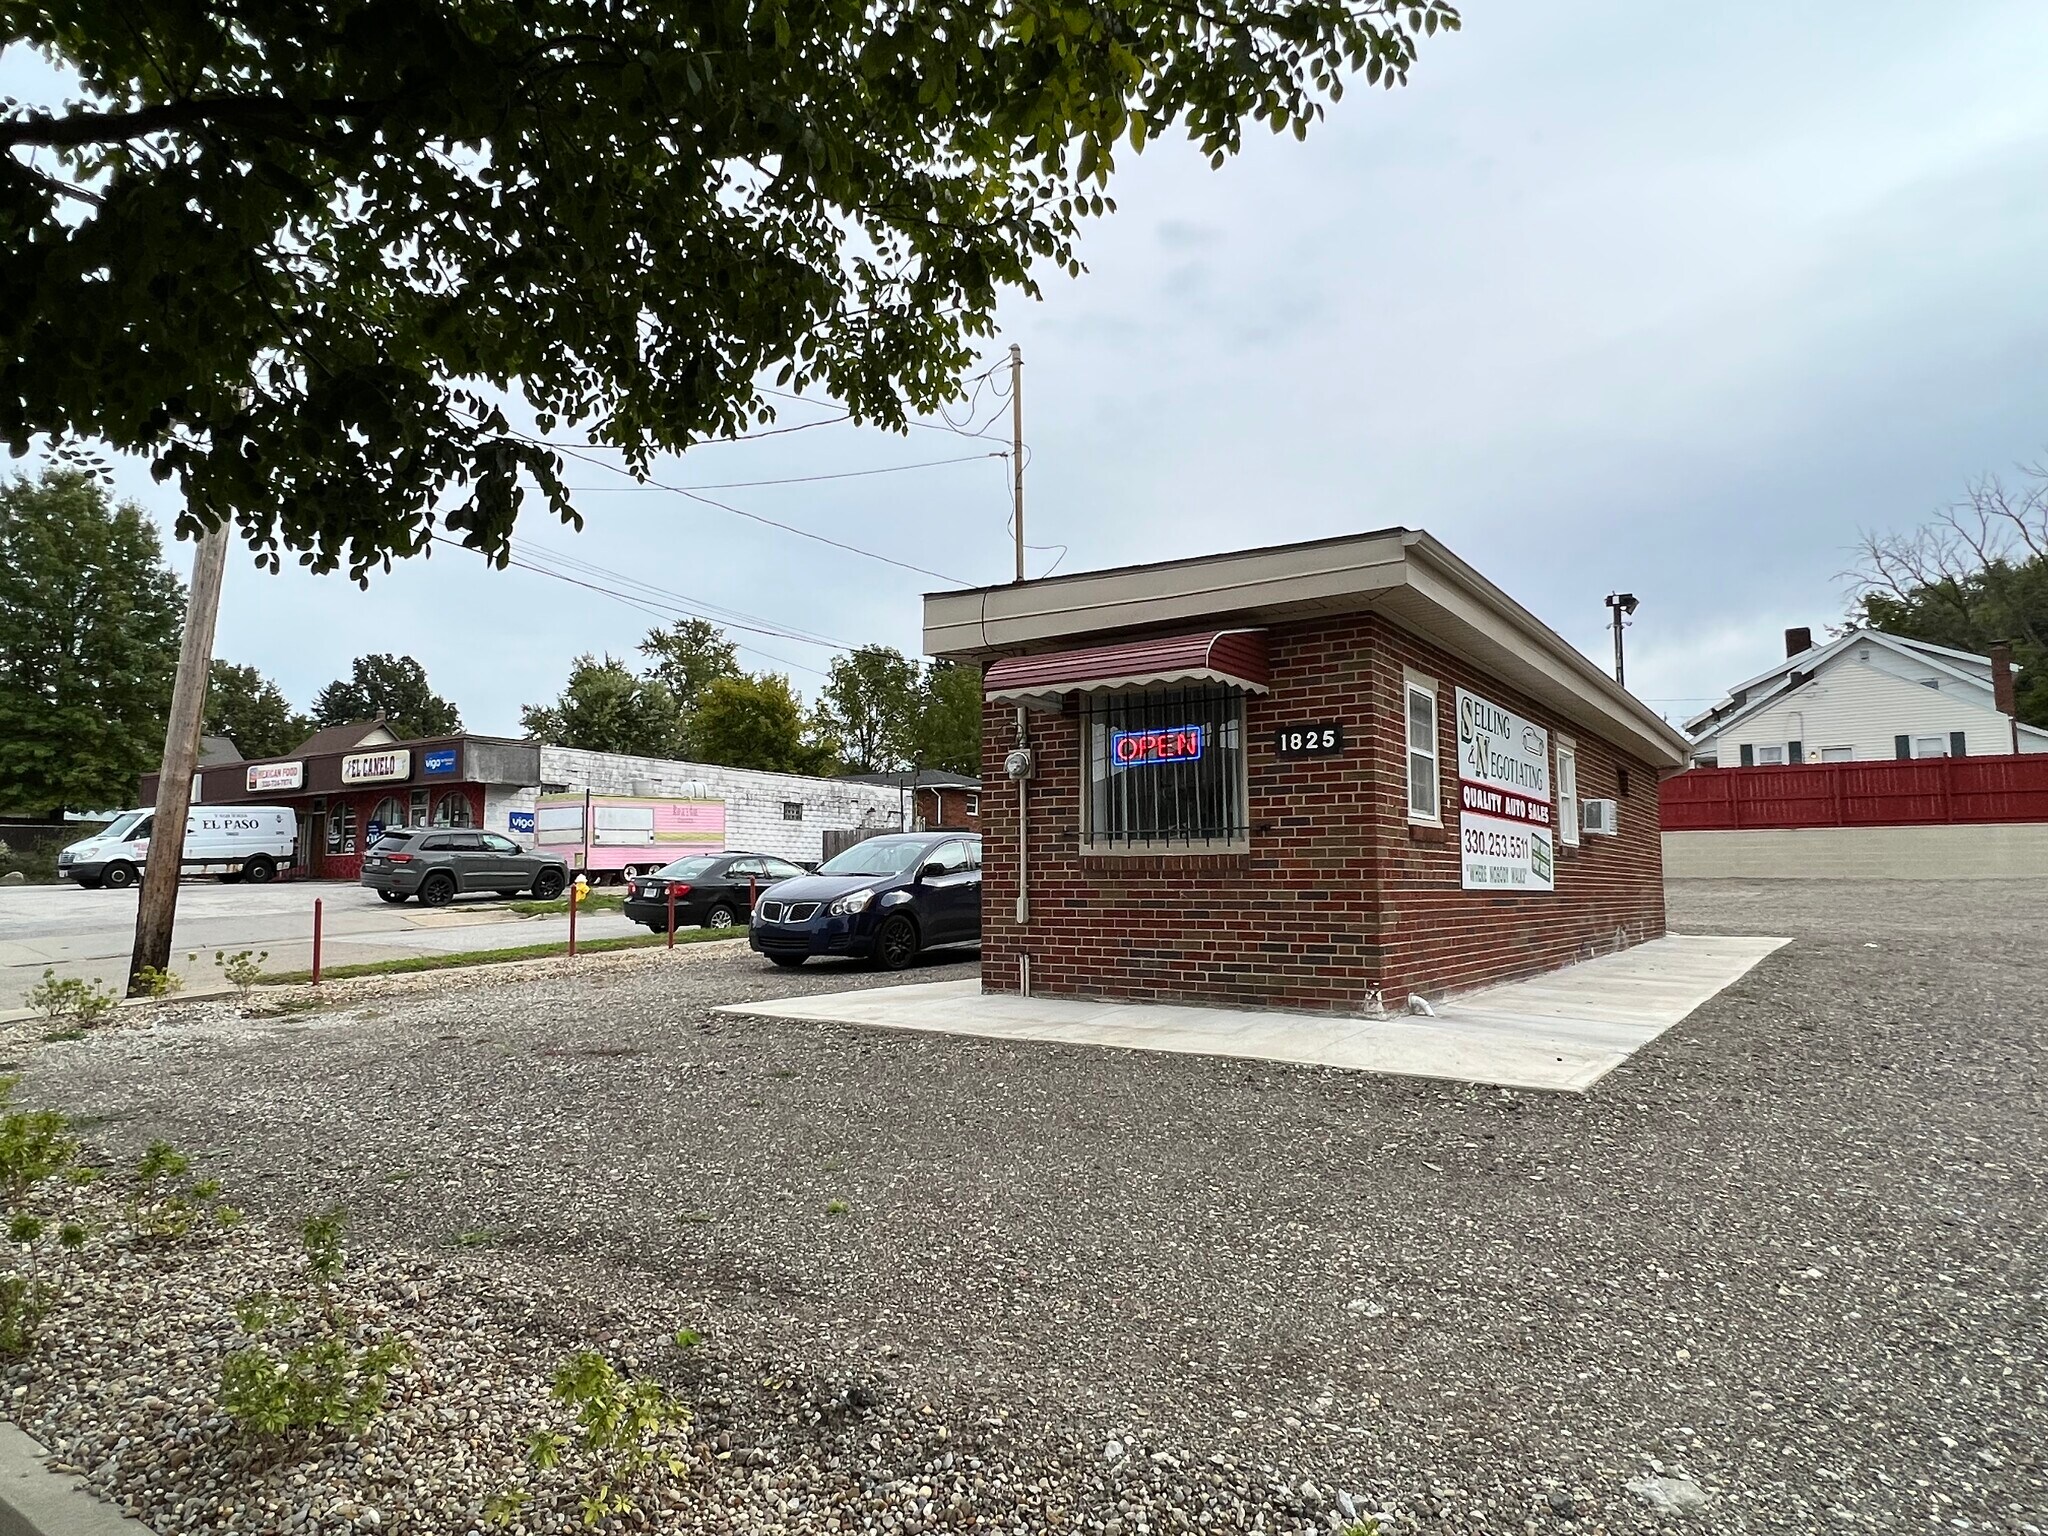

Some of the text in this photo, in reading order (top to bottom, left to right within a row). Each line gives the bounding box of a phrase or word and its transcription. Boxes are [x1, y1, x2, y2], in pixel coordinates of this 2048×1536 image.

[1461, 697, 1510, 744] SELLING
[1117, 732, 1197, 761] OPEN
[1281, 730, 1336, 751] 1825
[256, 767, 298, 779] MEXICAN FOOD
[351, 755, 395, 778] EL CANELO
[425, 757, 441, 770] vigo
[1476, 732, 1543, 791] NEGOTIATING
[1463, 785, 1549, 824] QUALITY AUTO SALES
[203, 820, 259, 829] EL PASO
[512, 816, 534, 829] vigo
[1464, 828, 1529, 859] 330.253.5511
